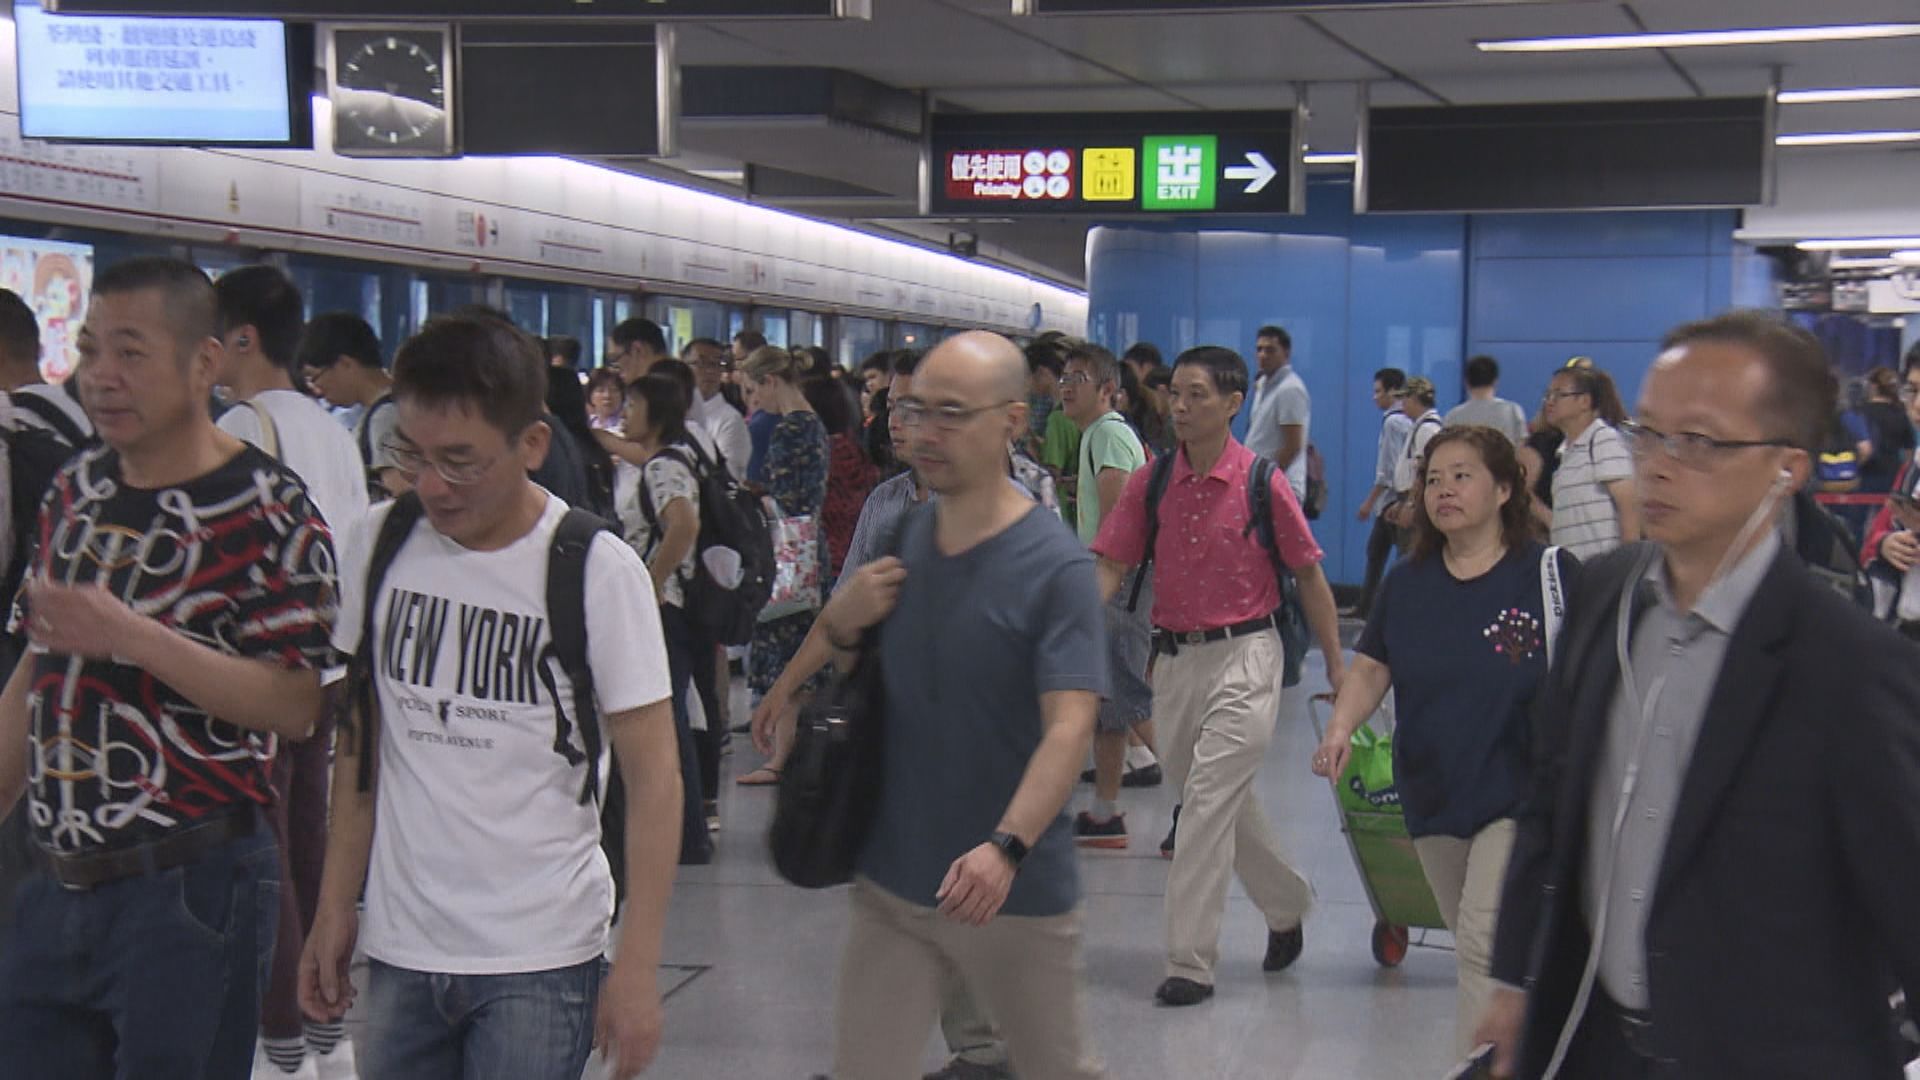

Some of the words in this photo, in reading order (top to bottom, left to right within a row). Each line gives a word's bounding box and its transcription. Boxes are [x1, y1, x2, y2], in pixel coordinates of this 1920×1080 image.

[1157, 186, 1200, 200] EXIT
[383, 588, 449, 687] NEW
[455, 603, 545, 705] YORK
[455, 705, 511, 722] SPORT
